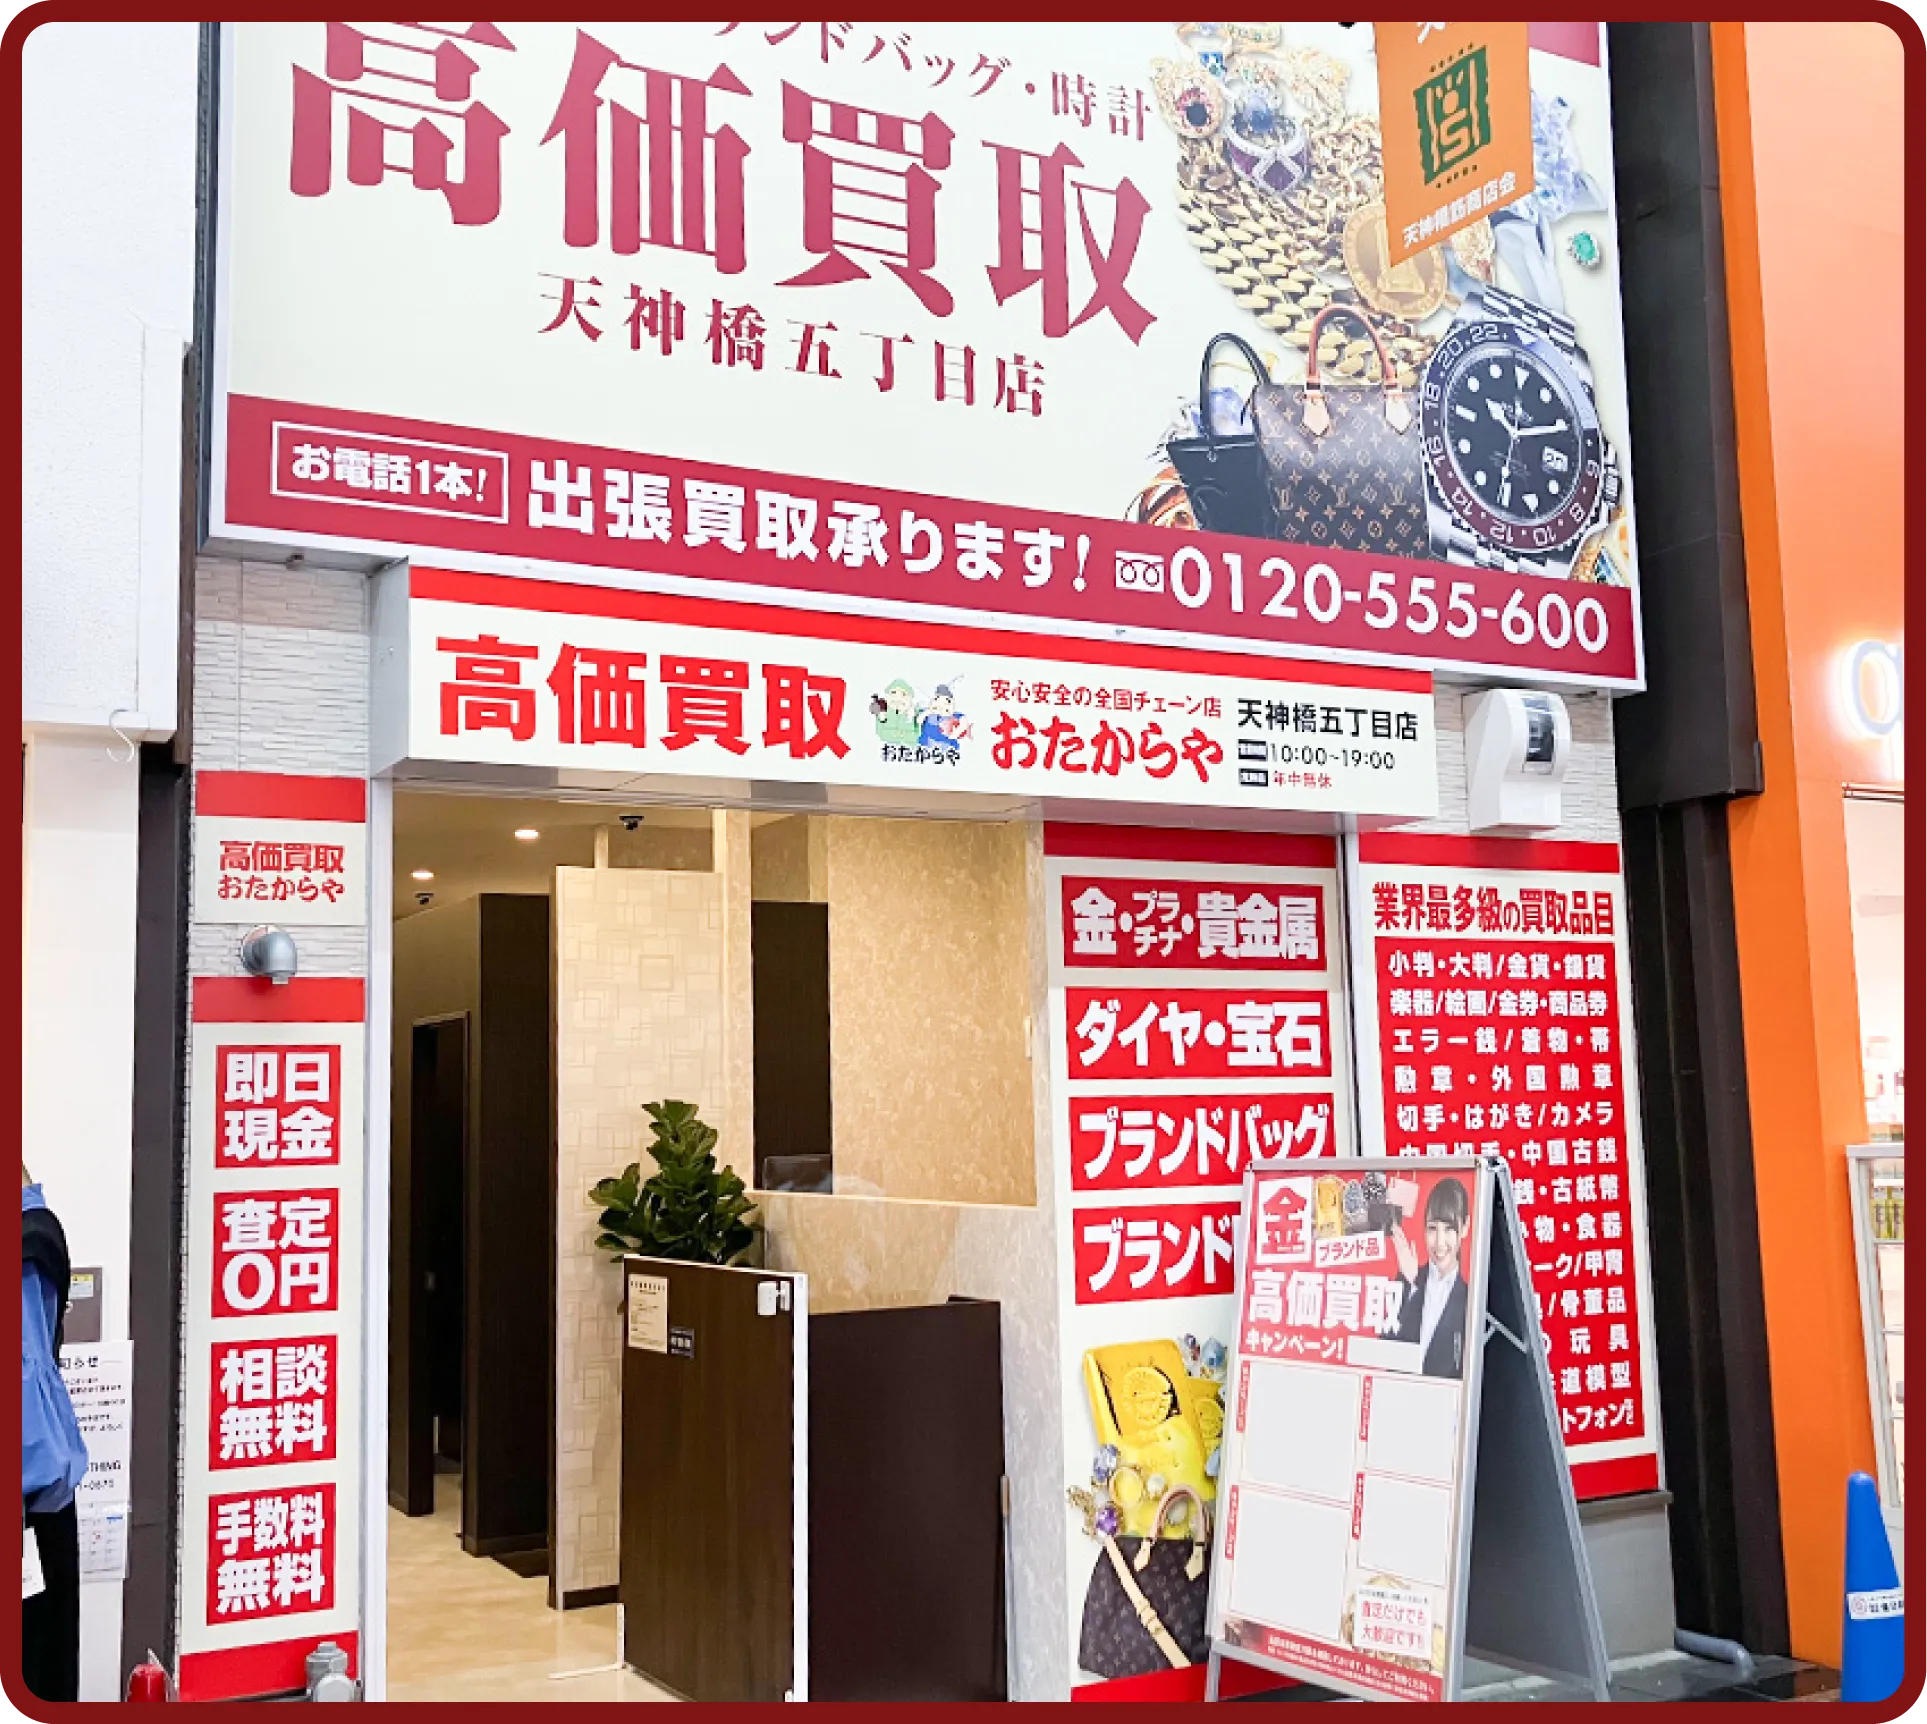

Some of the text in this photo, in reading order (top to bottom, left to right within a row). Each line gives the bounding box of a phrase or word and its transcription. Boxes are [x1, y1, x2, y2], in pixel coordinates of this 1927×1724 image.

[291, 22, 1157, 346] 高価買取
[538, 272, 1045, 416] 天神橋五丁目店
[527, 459, 1091, 593] 出張買取承ります!
[1169, 545, 1609, 654] 0120-555-600
[434, 634, 849, 760] 高価買取
[990, 678, 1223, 719] 安心安全の全国チェーン店
[1238, 698, 1419, 742] 天神橋五丁目店
[882, 743, 961, 767] おたからや
[991, 710, 1225, 784] おたからや
[219, 840, 345, 873] 高価買取
[217, 874, 346, 903] おたからや
[1373, 881, 1616, 937] 業界最多級の買取品目
[1075, 999, 1323, 1068] ダイヤ・宝石
[224, 1052, 332, 1105] 即日
[223, 1105, 335, 1162] 現金
[1079, 1103, 1331, 1180] ブランドバッグ
[1396, 1101, 1614, 1133] 切手・はがき/カメラ
[221, 1197, 333, 1252] 査定
[1263, 1186, 1308, 1254] 金
[1319, 1237, 1380, 1262] ブランド品
[1083, 1215, 1241, 1293] ブランド
[1249, 1267, 1404, 1336] 高価買取
[219, 1343, 328, 1403] 相談
[1245, 1327, 1345, 1360] キャンペーン!
[1549, 1360, 1632, 1396] 道模型
[219, 1398, 329, 1460] 無料
[216, 1491, 326, 1556] 手数料
[216, 1548, 327, 1615] 無料
